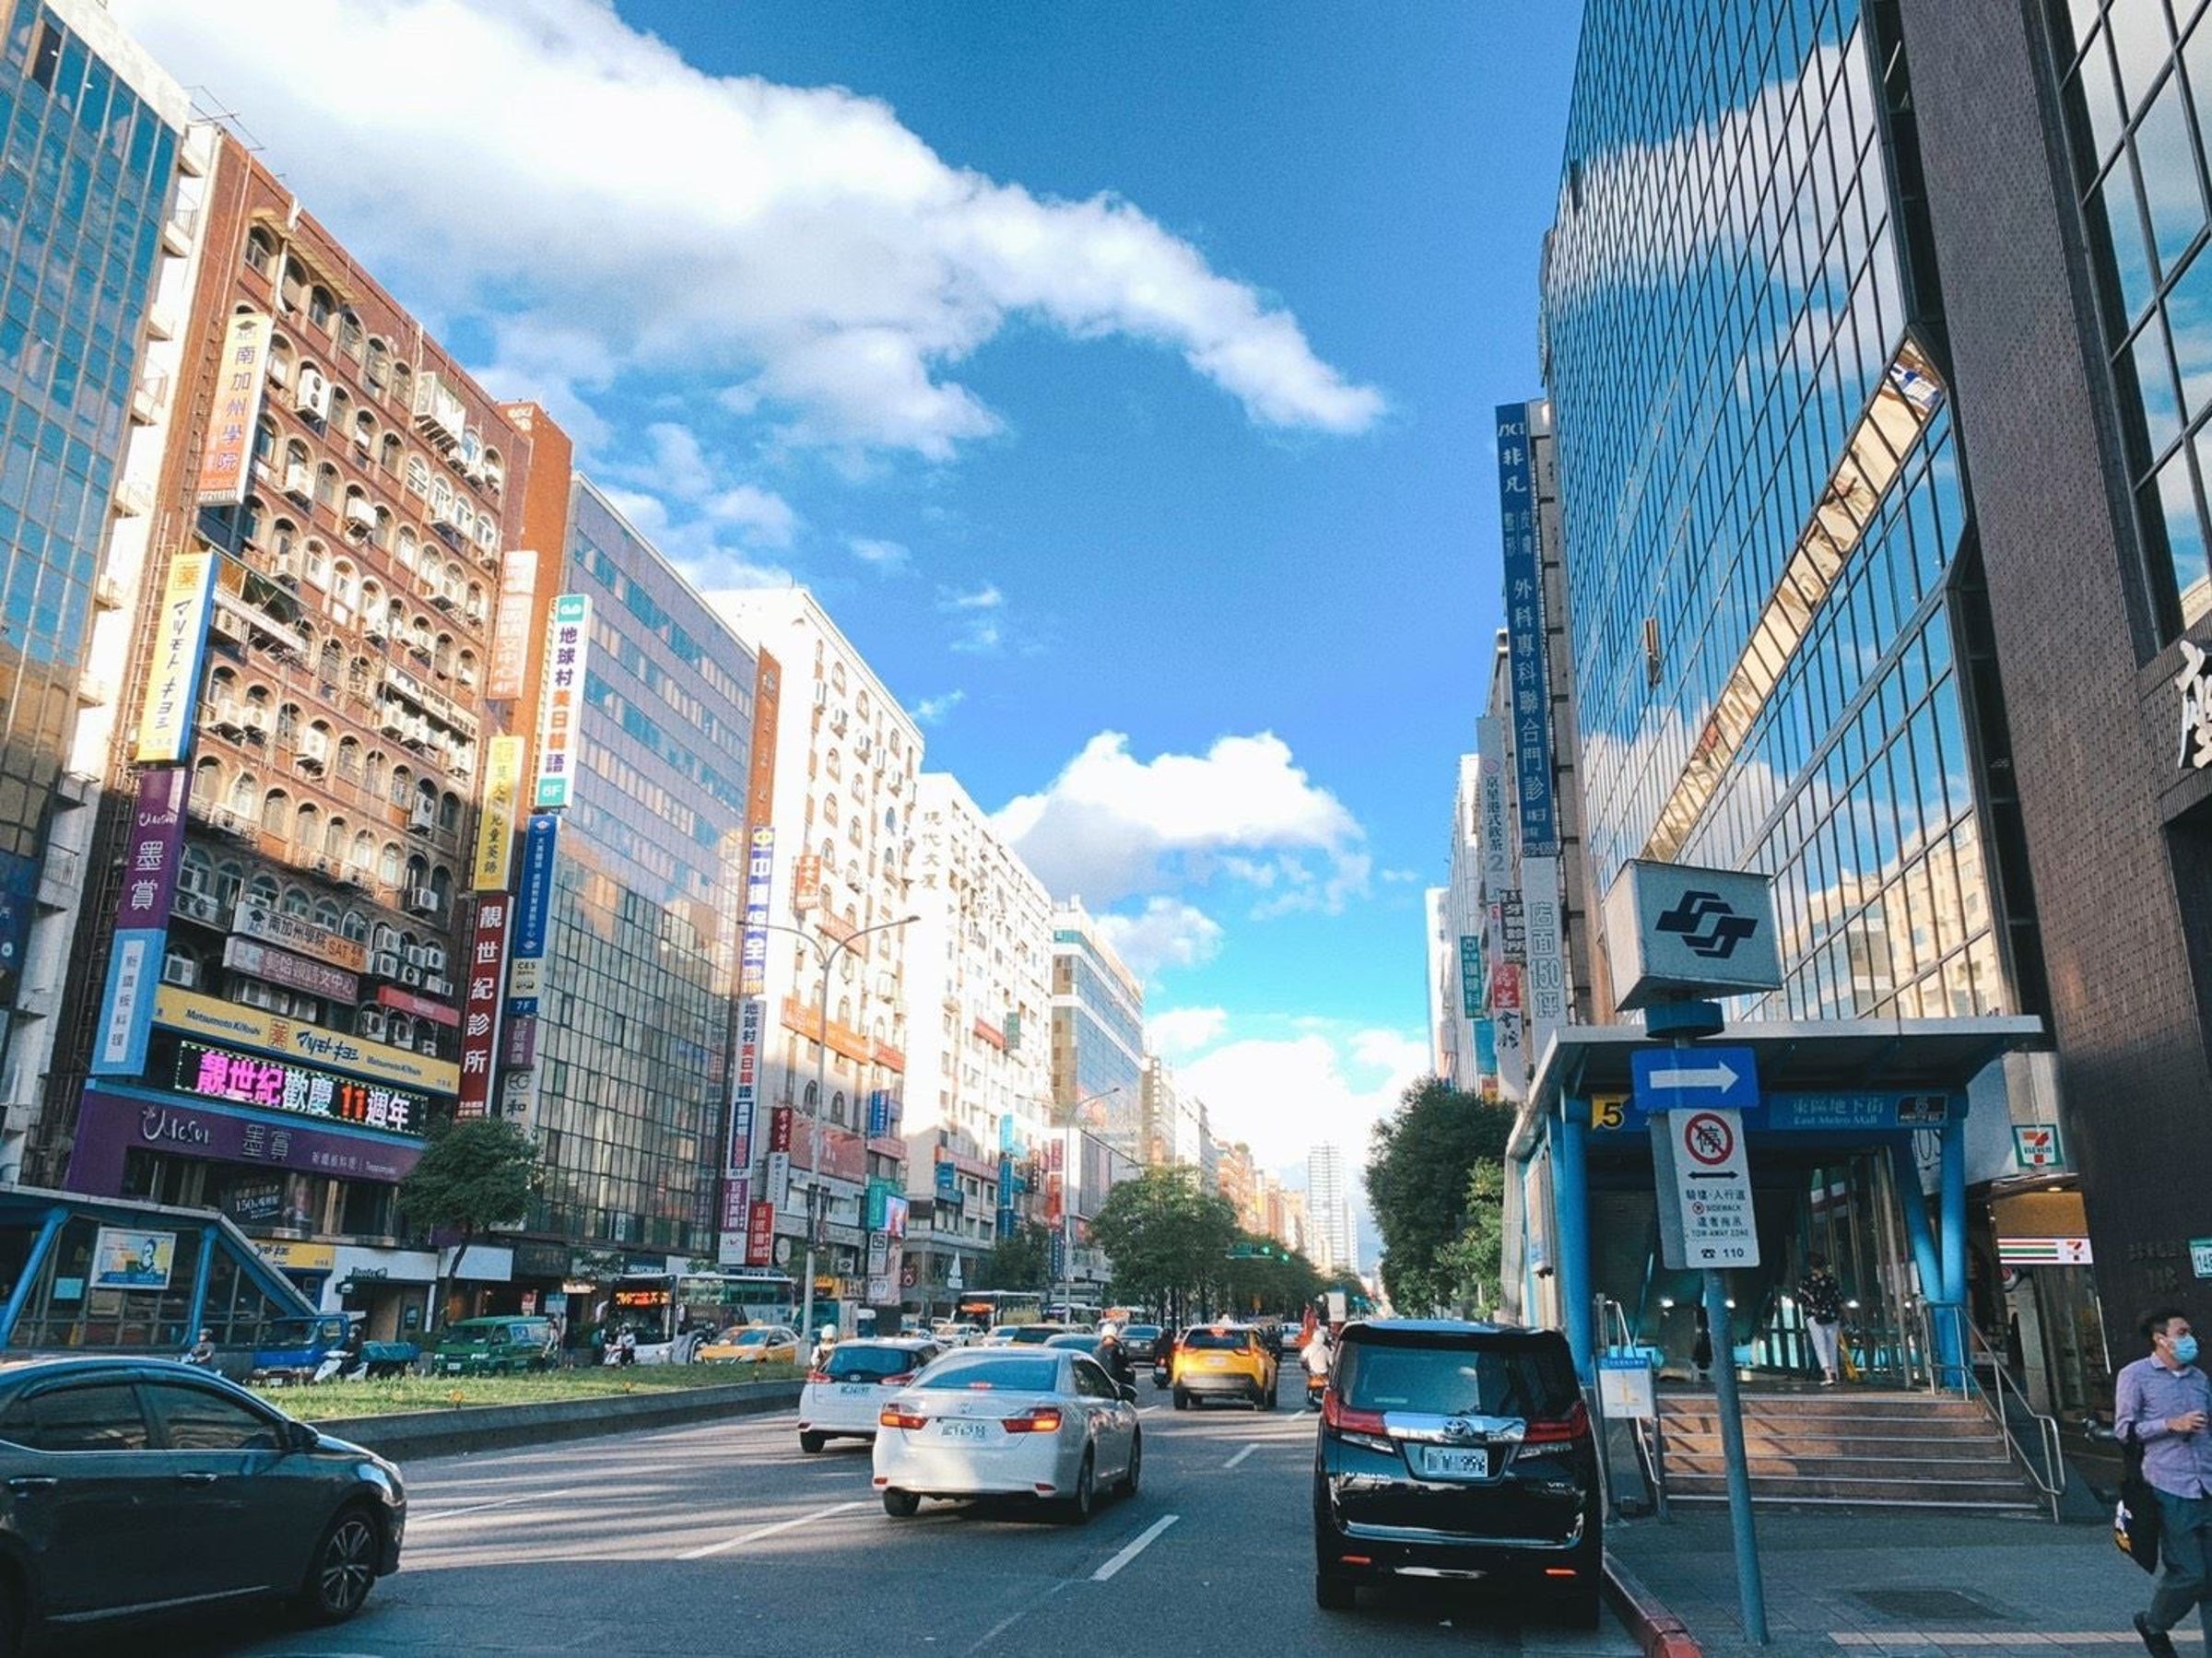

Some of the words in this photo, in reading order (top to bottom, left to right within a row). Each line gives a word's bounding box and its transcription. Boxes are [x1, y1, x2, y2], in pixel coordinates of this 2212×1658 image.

[218, 347, 255, 470] 南加州學院
[1502, 448, 1527, 493] 非凡
[155, 599, 192, 730] マツモトキヨシ
[1514, 578, 1545, 802] 外科專科聯合門診
[131, 840, 164, 911] 墨賞
[328, 941, 349, 959] SAT
[1530, 901, 1562, 1018] 店面150坪
[463, 906, 502, 1075] 靚世紀診所
[1603, 1102, 1624, 1129] 5
[1706, 1204, 1742, 1212] SIDEWALK
[1723, 1248, 1745, 1258] 110
